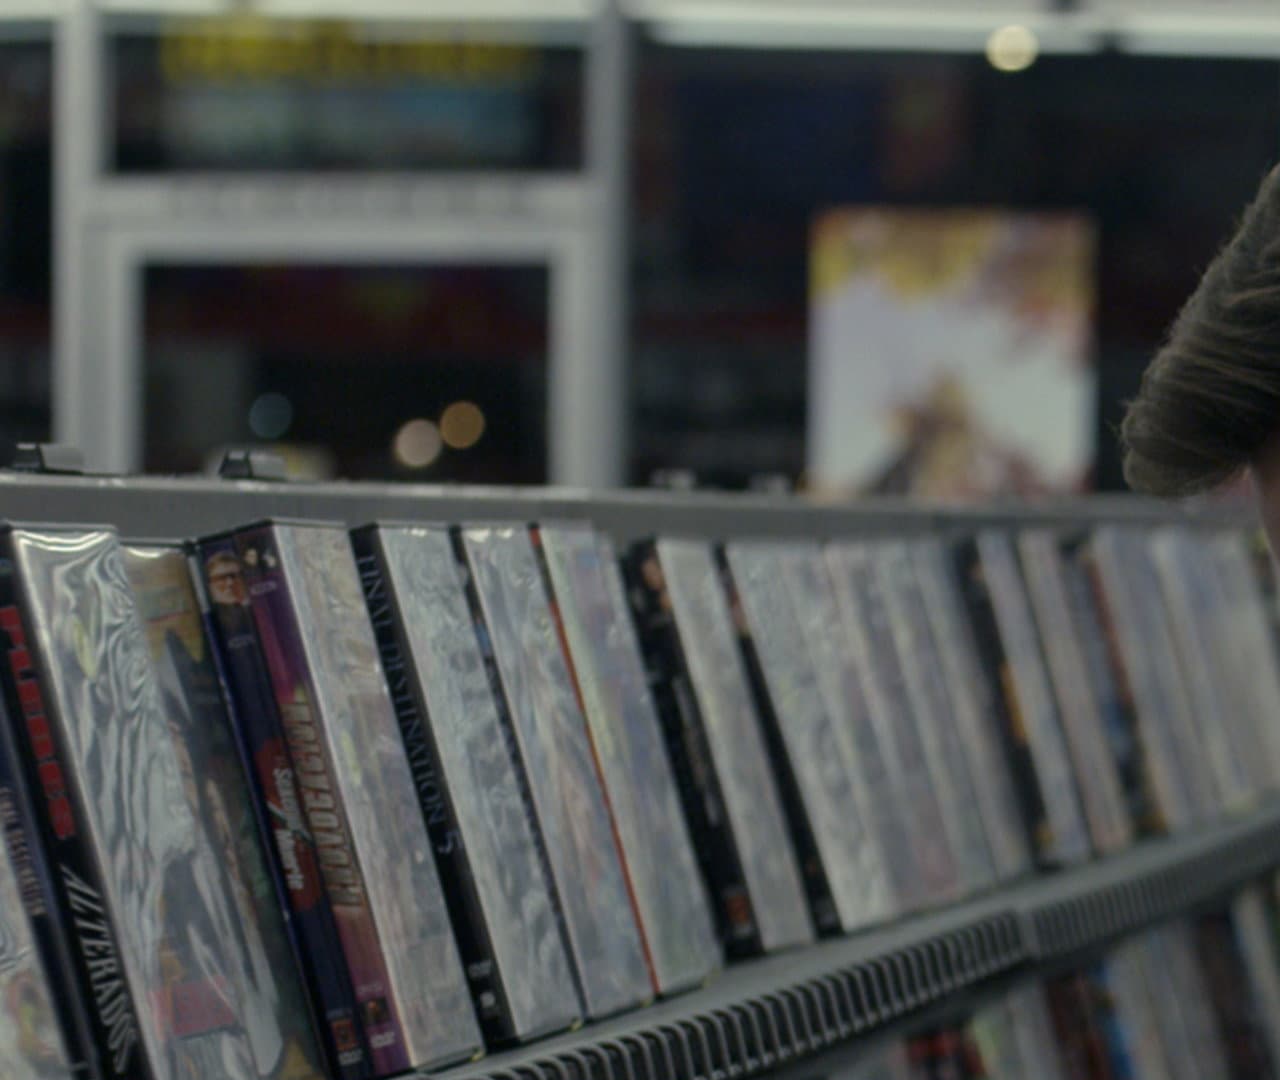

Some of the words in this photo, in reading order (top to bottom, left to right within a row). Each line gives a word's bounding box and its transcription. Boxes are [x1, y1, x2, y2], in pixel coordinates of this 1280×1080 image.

[358, 556, 393, 627] FINAL
[382, 640, 447, 826] DESTINATION
[438, 830, 461, 856] 5
[60, 864, 136, 1075] ALTERADOS
